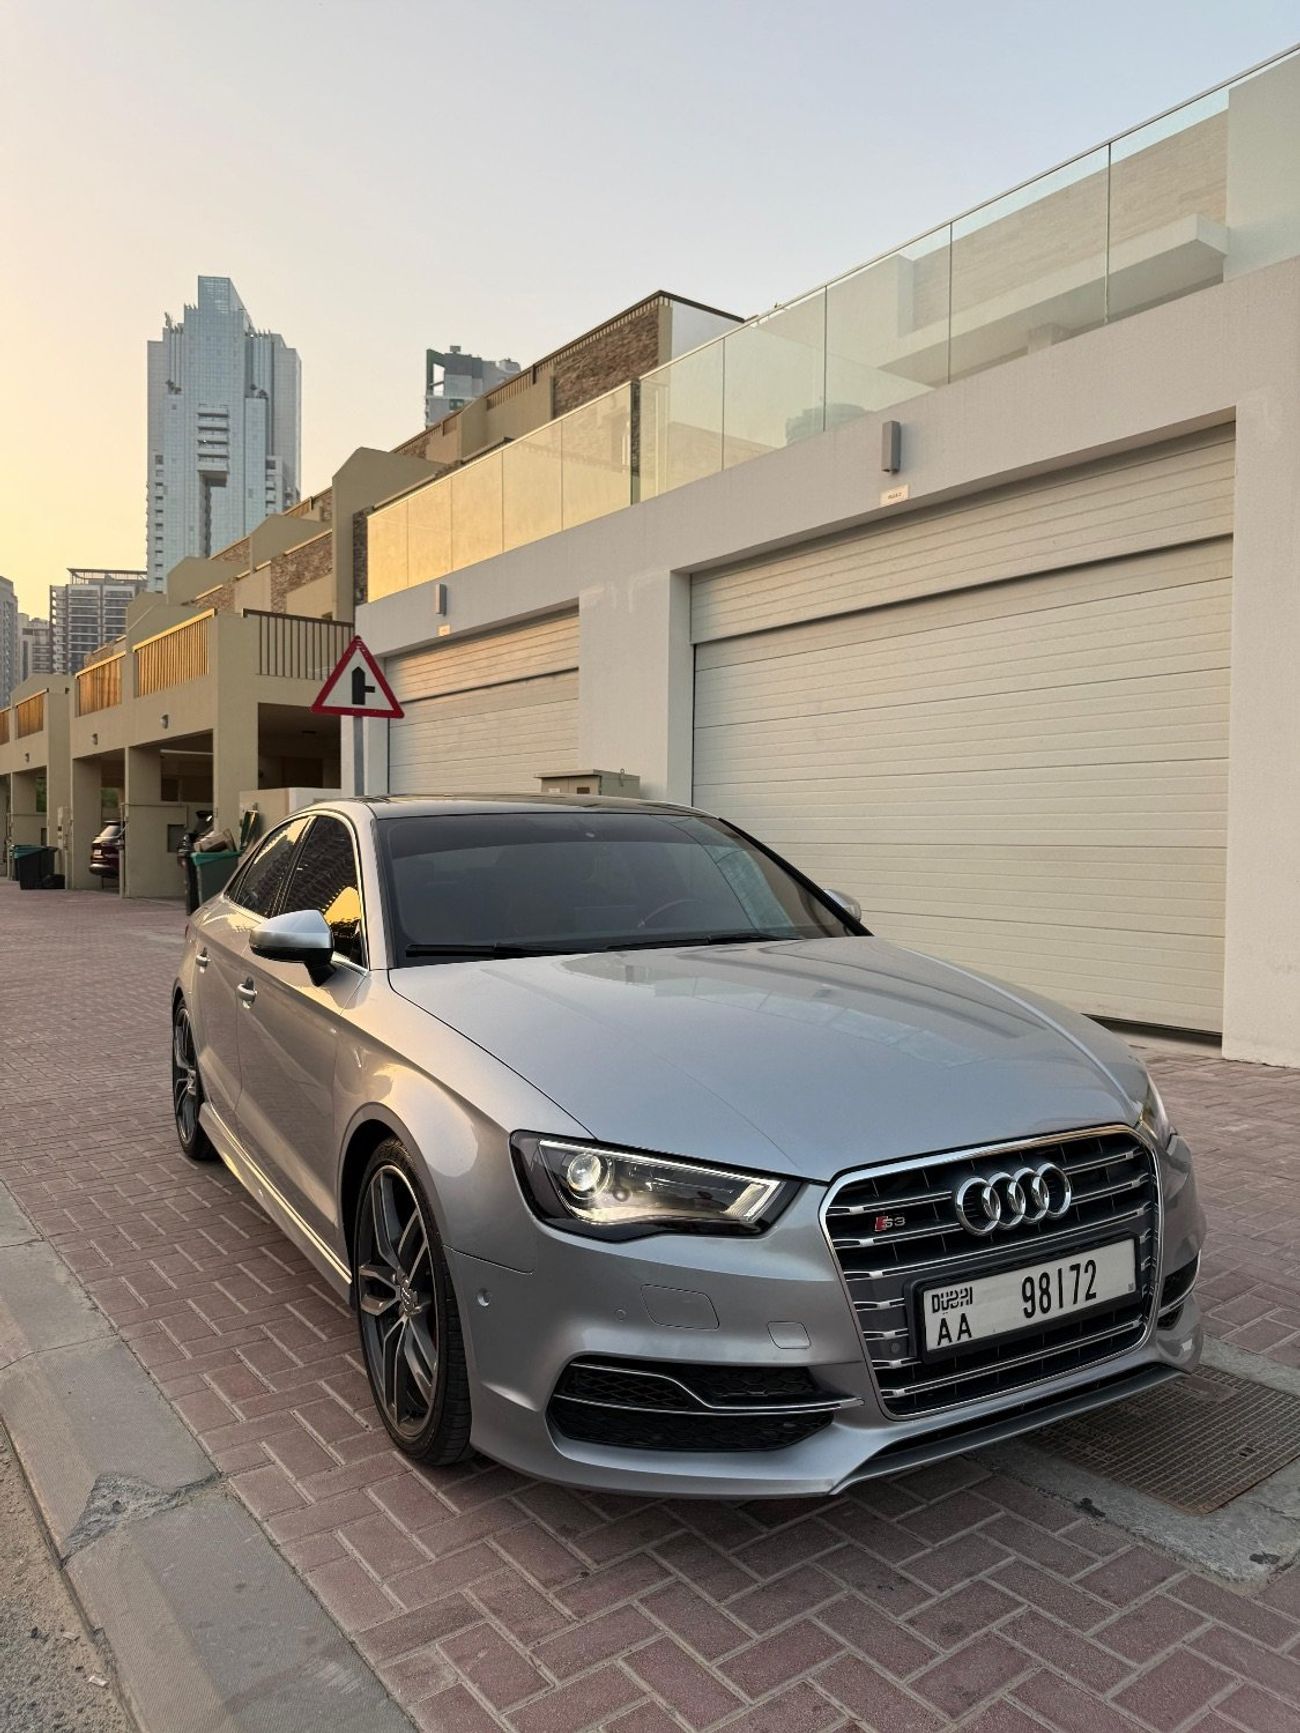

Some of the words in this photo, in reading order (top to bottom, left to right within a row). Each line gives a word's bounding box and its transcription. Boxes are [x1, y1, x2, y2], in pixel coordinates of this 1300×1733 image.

[880, 1216, 906, 1229] S3
[1021, 1259, 1097, 1319] 98172
[937, 1313, 972, 1346] AA
